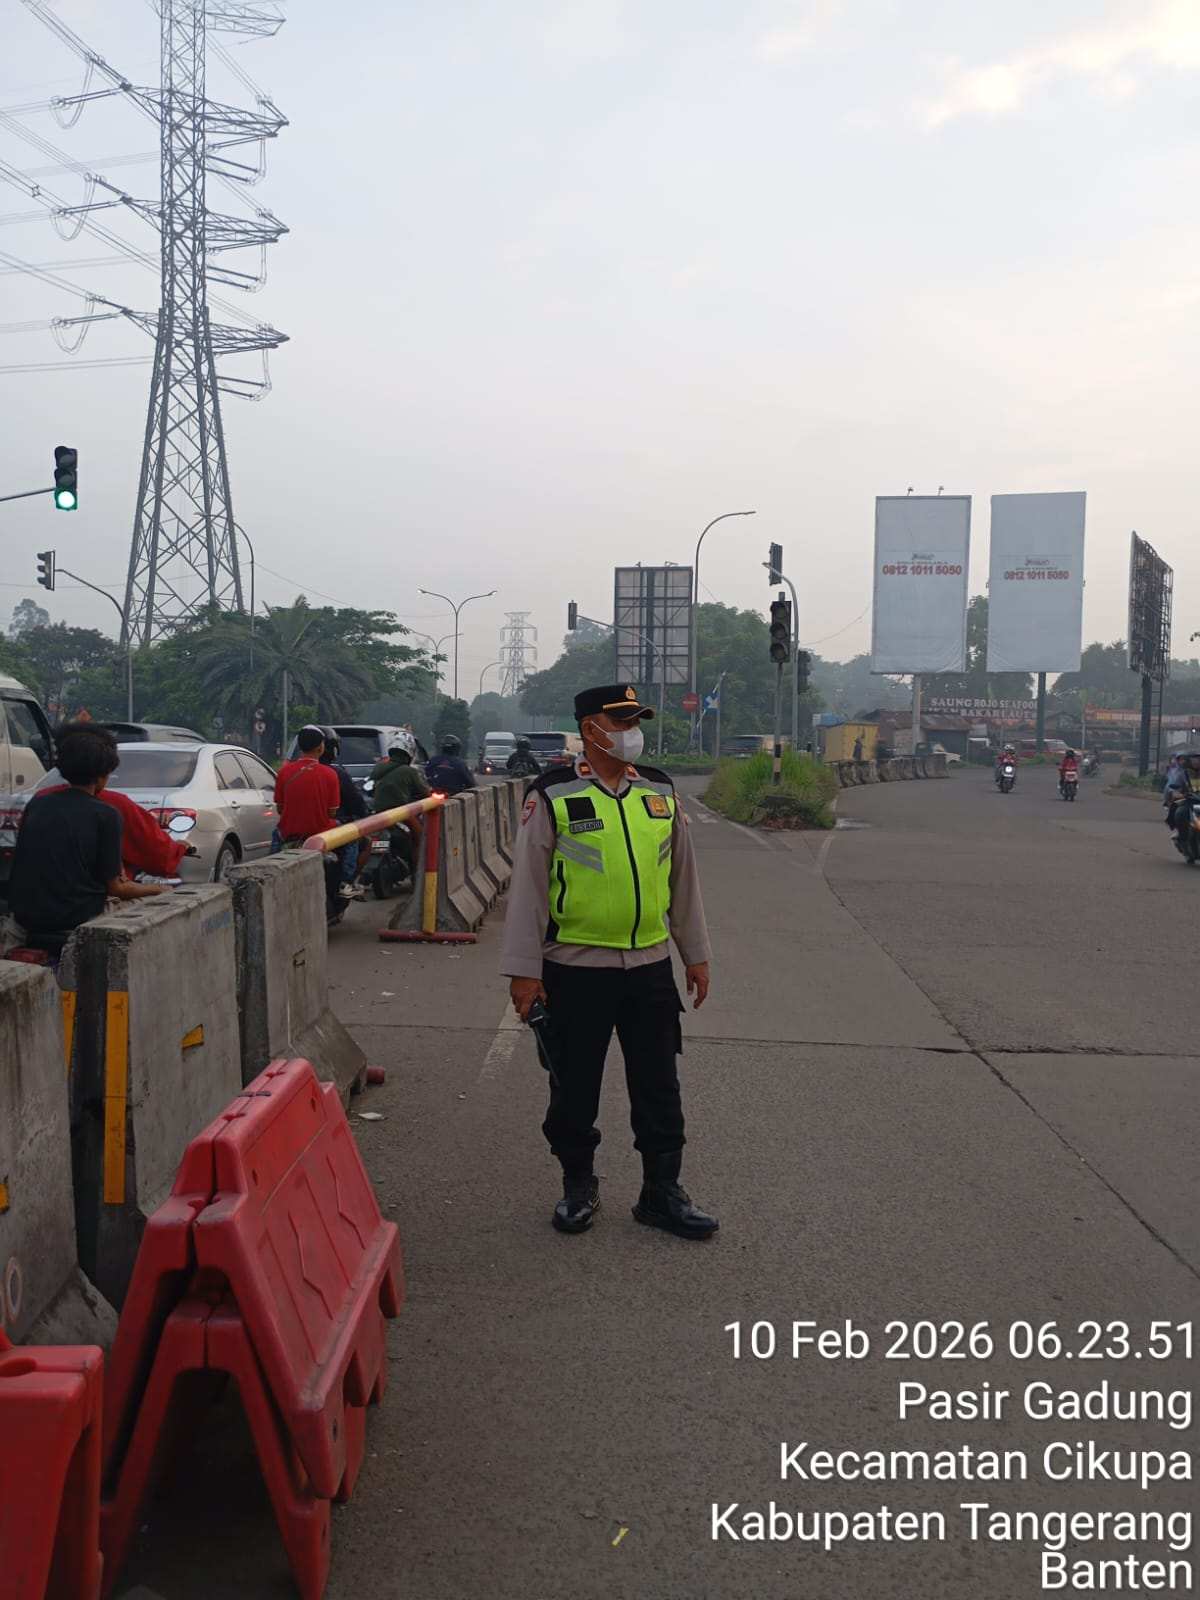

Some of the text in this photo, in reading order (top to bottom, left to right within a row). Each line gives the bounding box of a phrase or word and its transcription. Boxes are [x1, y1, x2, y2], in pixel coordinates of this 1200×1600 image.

[882, 564, 908, 575] 0812
[910, 564, 933, 575] 1011
[1003, 570, 1025, 580] 0812
[931, 697, 973, 708] SAUNG
